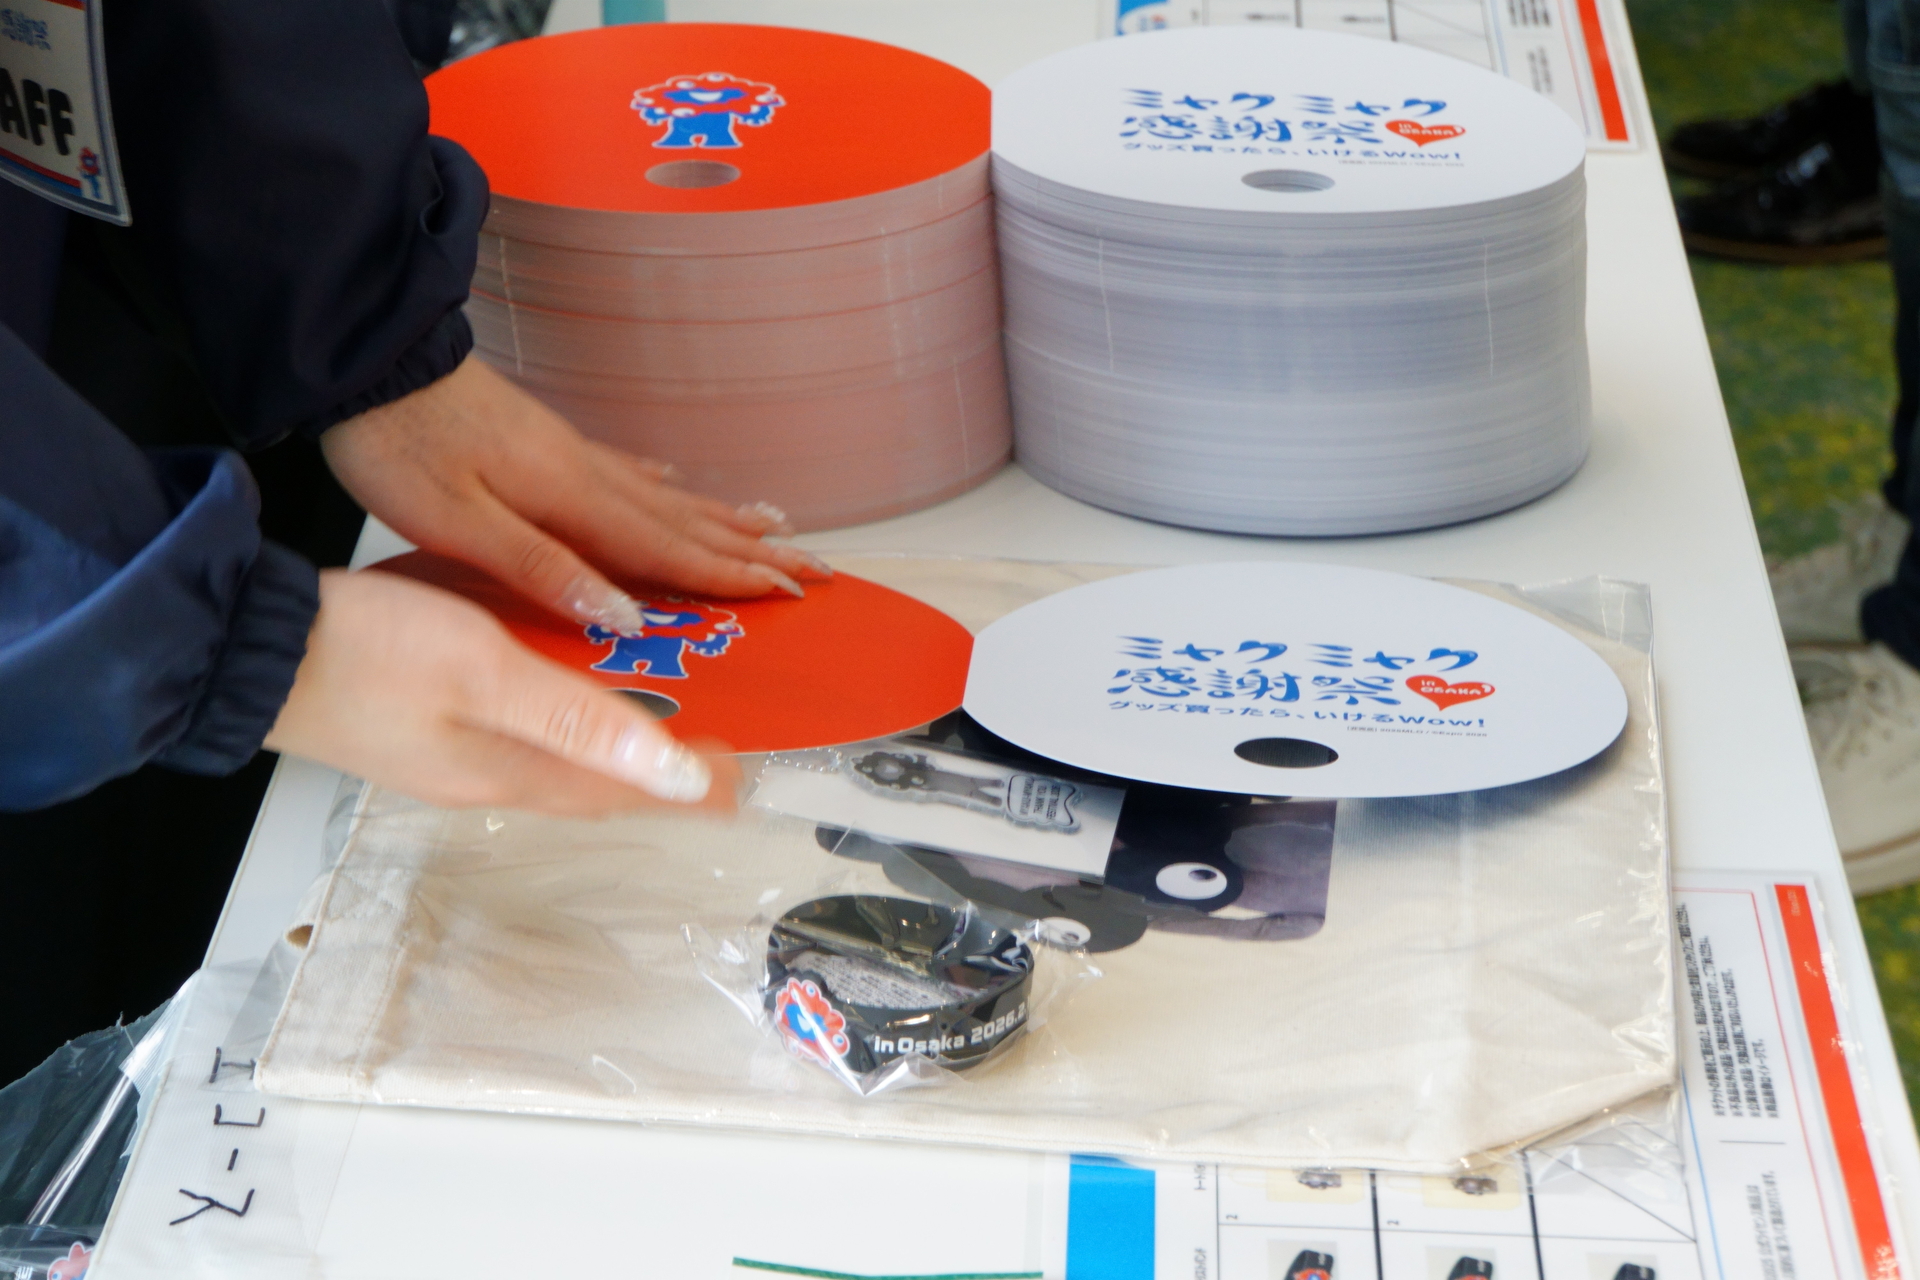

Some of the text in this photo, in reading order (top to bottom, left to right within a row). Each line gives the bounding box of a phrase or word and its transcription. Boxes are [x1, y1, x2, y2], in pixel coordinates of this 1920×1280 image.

[1119, 114, 1383, 144] 感謝祭
[1107, 666, 1402, 706] 感謝祭
[1420, 679, 1436, 687] in
[1420, 686, 1481, 696] OSAKA
[874, 1035, 894, 1053] in
[897, 1034, 965, 1054] Osaka
